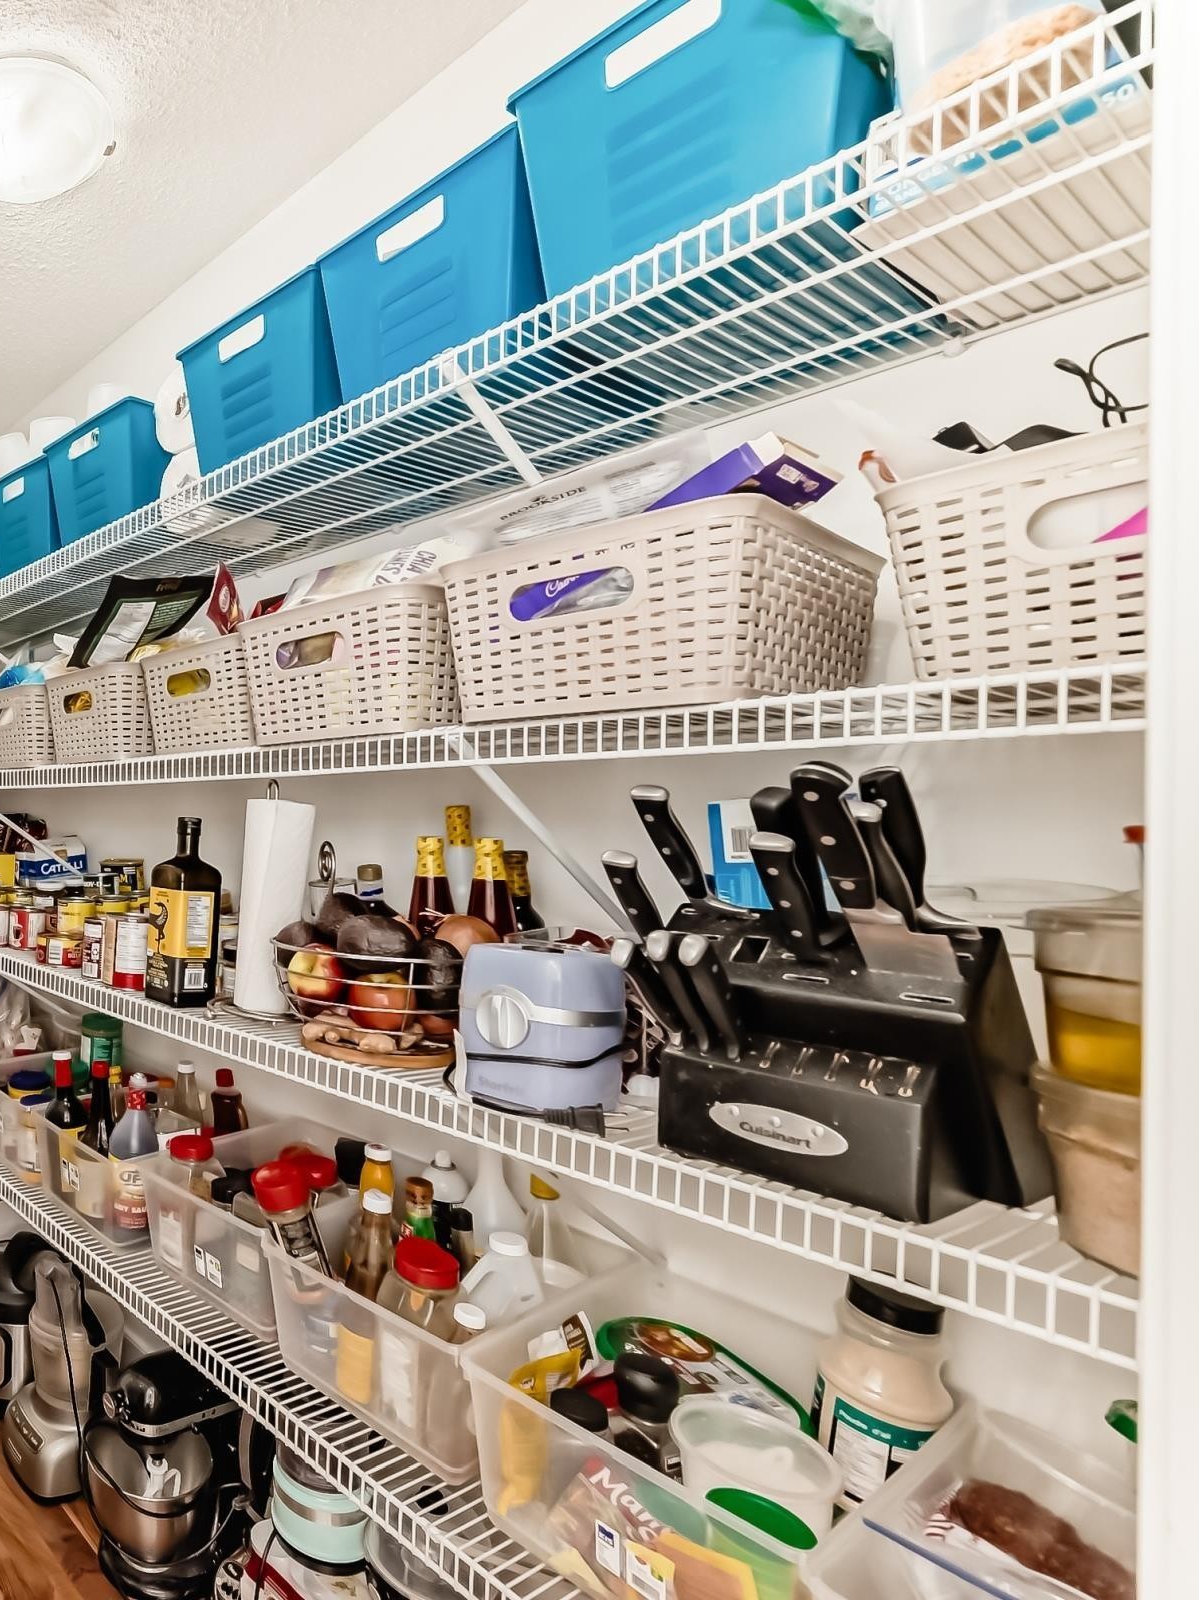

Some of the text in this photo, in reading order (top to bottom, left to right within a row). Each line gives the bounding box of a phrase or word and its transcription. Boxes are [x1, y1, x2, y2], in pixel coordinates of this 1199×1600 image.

[500, 486, 587, 521] BROOKSIDE
[406, 550, 437, 574] CHIA
[739, 1121, 812, 1150] Cuisinart
